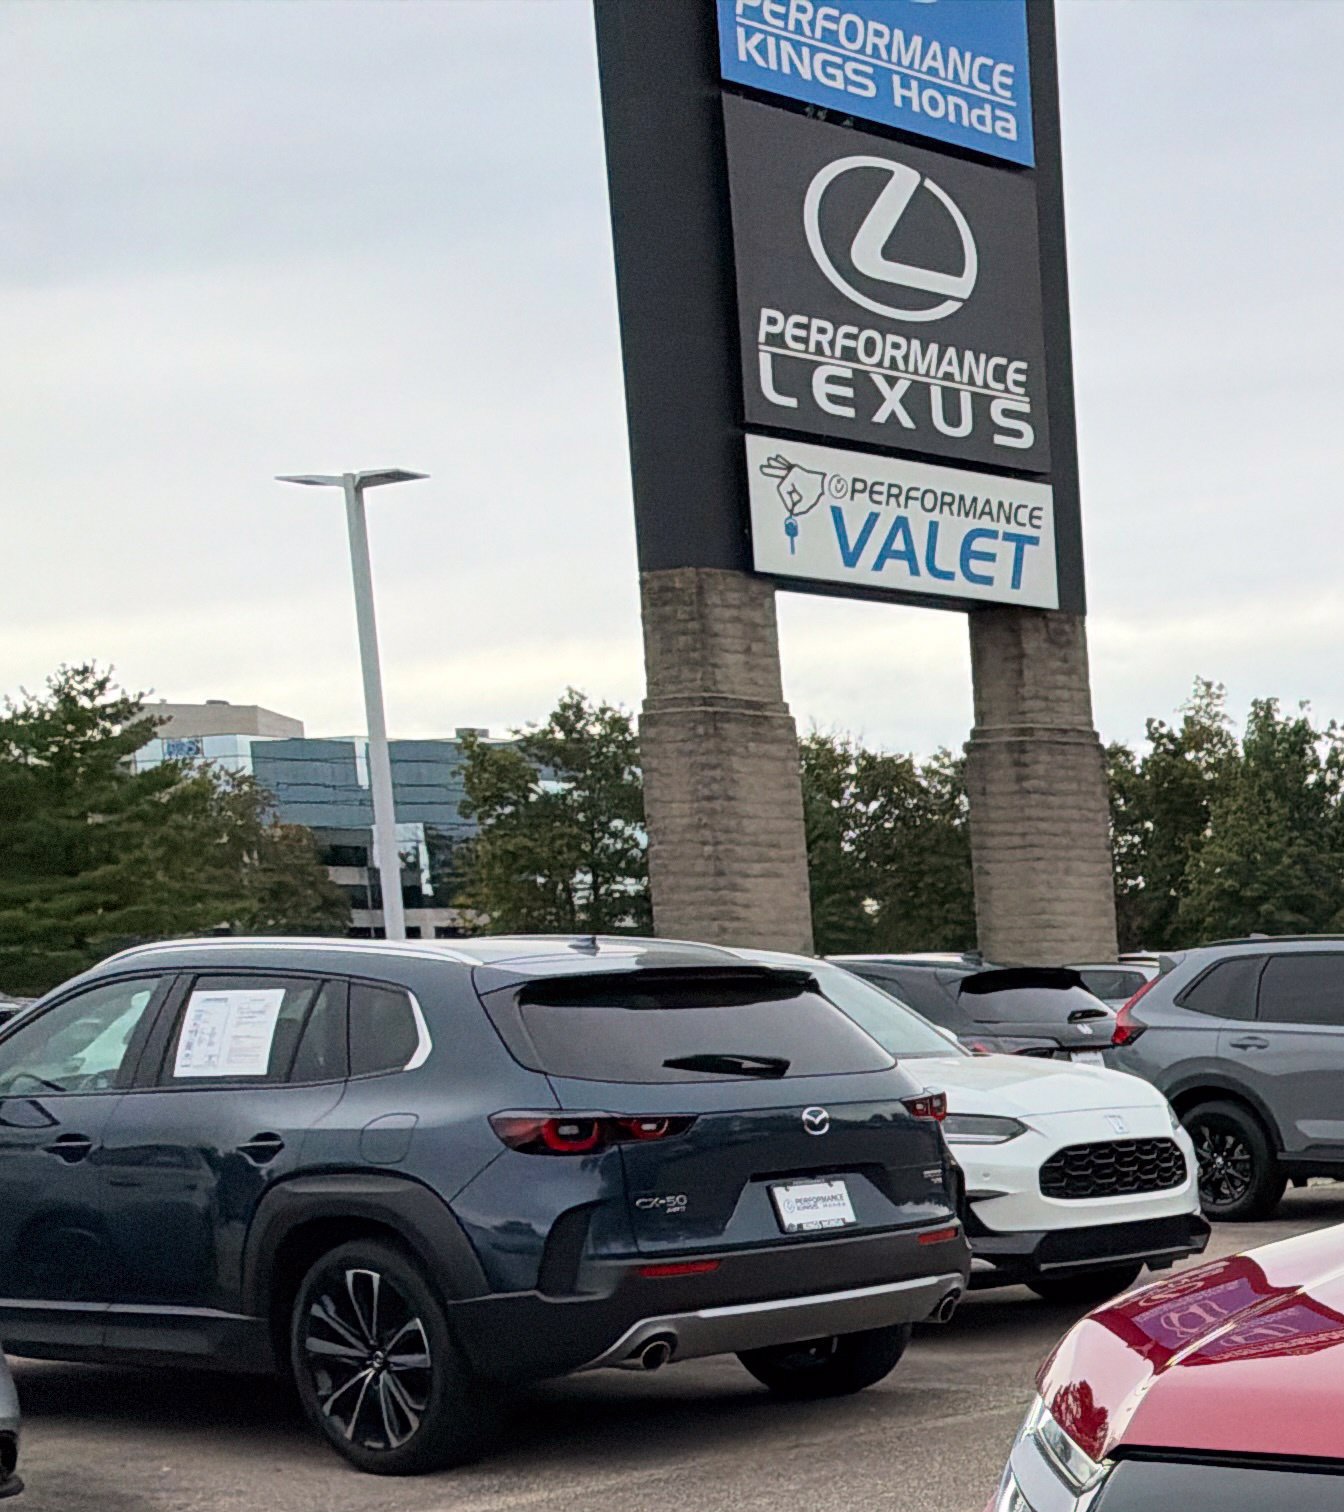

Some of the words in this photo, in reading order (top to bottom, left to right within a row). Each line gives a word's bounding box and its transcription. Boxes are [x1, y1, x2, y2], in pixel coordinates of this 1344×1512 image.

[736, 26, 877, 98] KINGS
[892, 74, 1018, 141] Honda
[758, 307, 1029, 394] PERFORMANCE
[758, 352, 1035, 449] LEXUS
[850, 477, 1044, 530] PERFORMANCE
[830, 505, 1040, 590] VALET
[635, 1194, 688, 1209] CX-50
